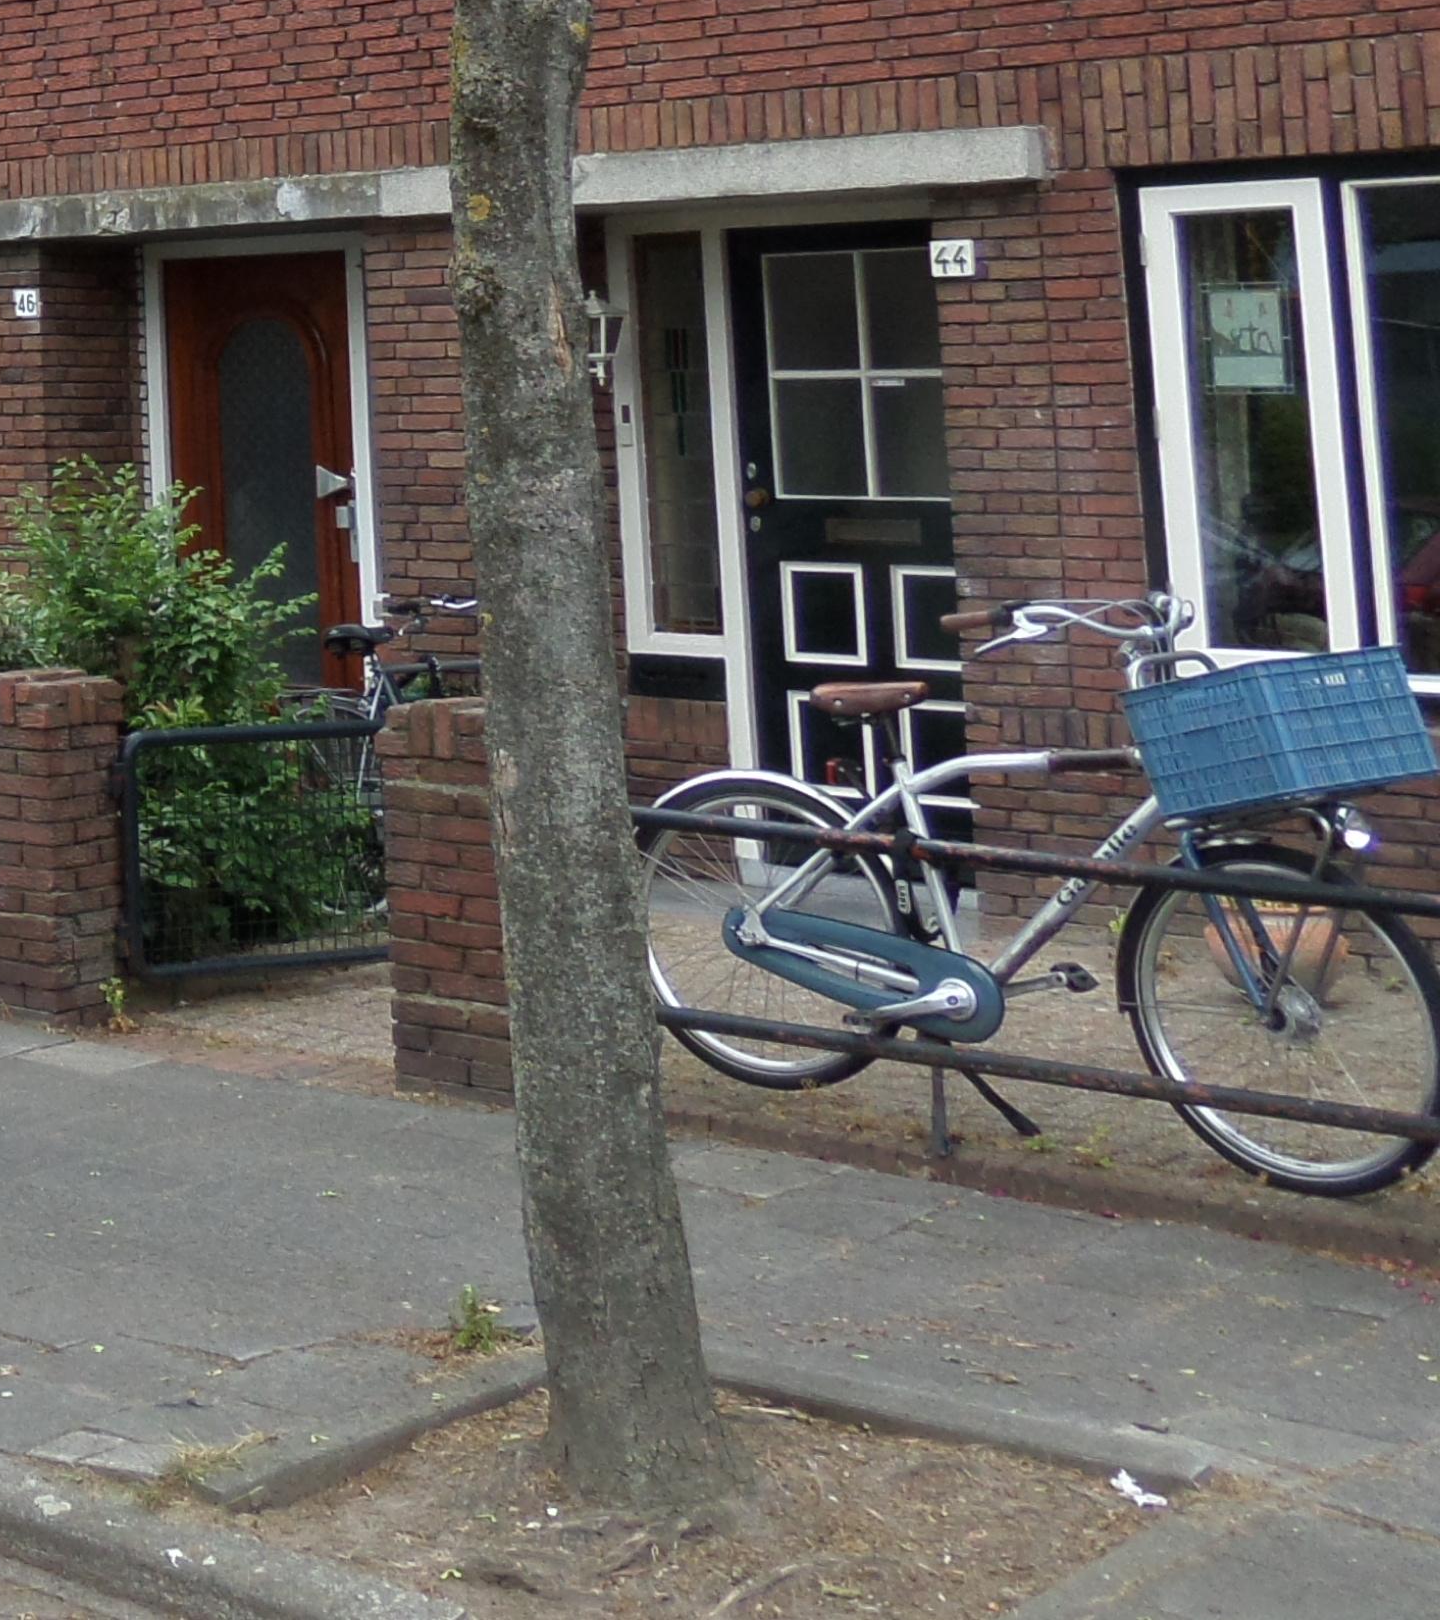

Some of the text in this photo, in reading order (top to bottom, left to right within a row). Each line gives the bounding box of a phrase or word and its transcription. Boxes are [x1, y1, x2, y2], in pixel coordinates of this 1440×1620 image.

[934, 245, 968, 275] 44
[18, 293, 36, 313] 46
[1057, 824, 1138, 906] Gaelle
